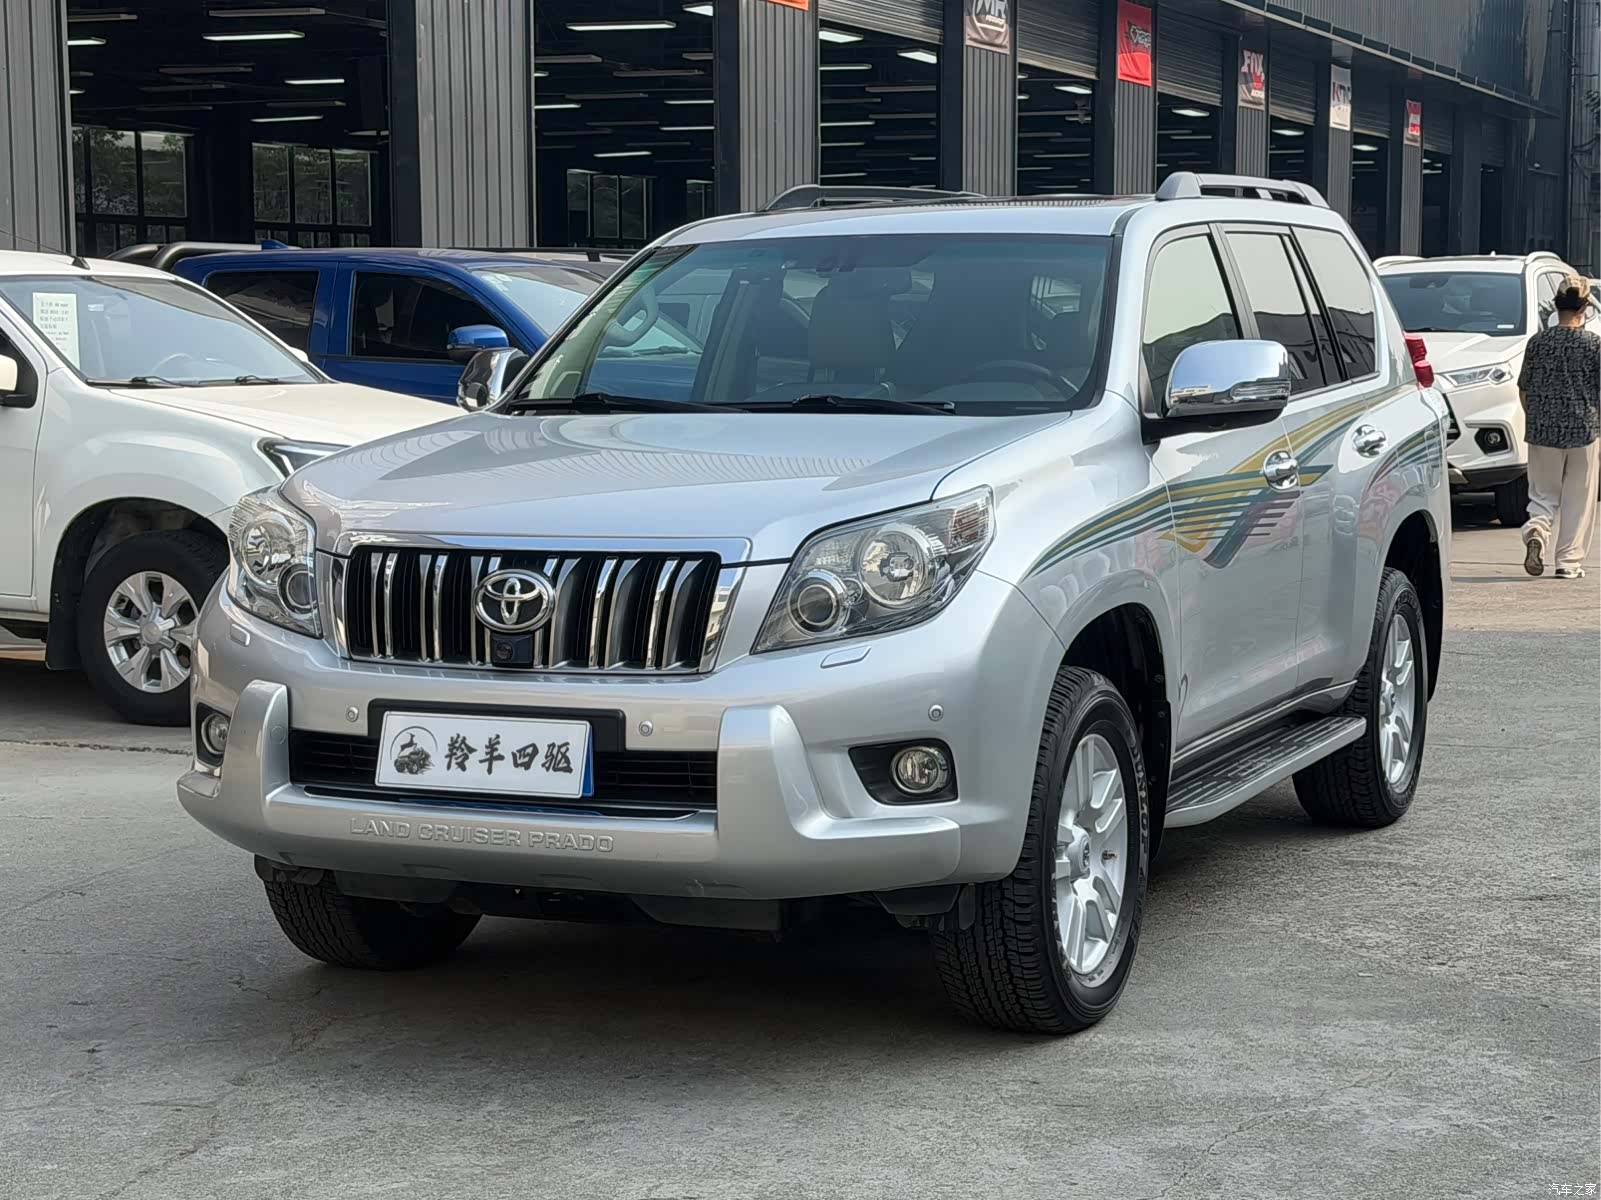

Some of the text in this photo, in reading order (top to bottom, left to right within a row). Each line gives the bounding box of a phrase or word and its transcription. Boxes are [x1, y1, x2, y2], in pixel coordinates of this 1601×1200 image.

[445, 733, 574, 775] 羚羊四驱
[351, 818, 615, 853] LAND CRUISER PRADO
